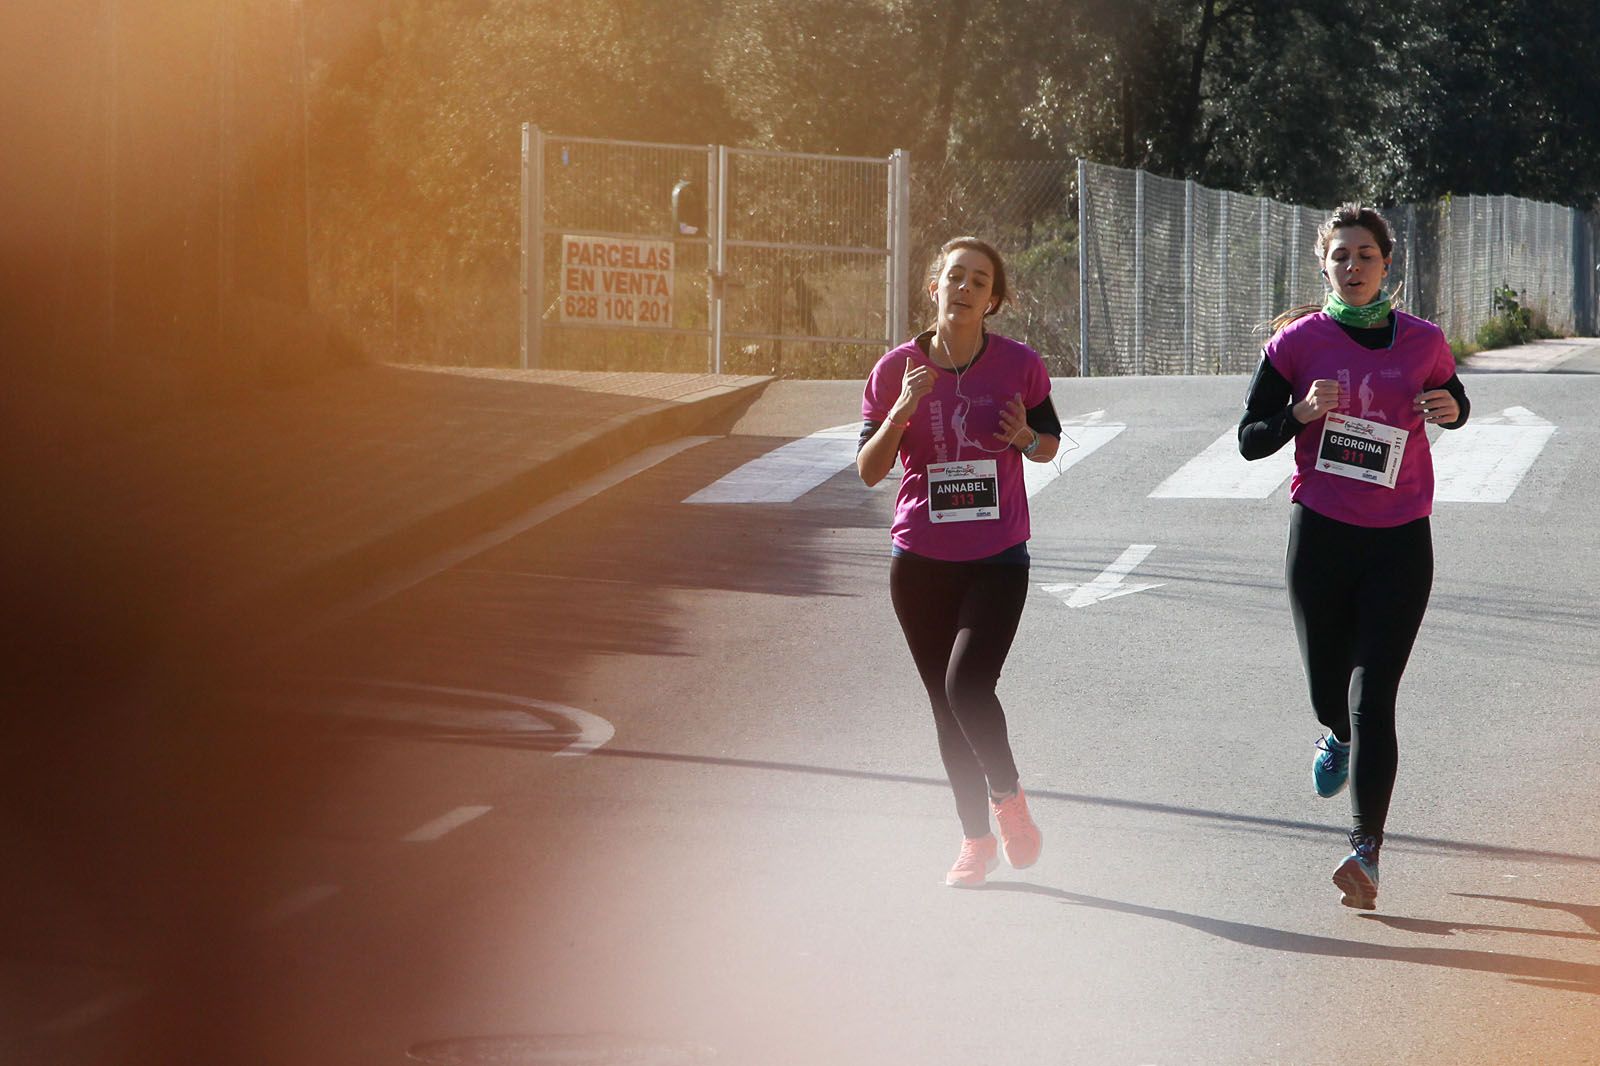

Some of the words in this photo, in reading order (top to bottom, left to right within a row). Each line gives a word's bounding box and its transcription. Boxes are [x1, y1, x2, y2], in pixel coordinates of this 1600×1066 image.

[567, 242, 670, 270] PARCELAS
[566, 268, 595, 292] EN
[602, 271, 669, 297] VENTA
[565, 296, 598, 319] 628
[604, 298, 634, 320] 100
[639, 300, 670, 323] 201
[1330, 435, 1382, 455] GEORGINA
[1343, 449, 1366, 464] 311
[937, 482, 988, 494] ANNABEL
[952, 493, 975, 506] 313
